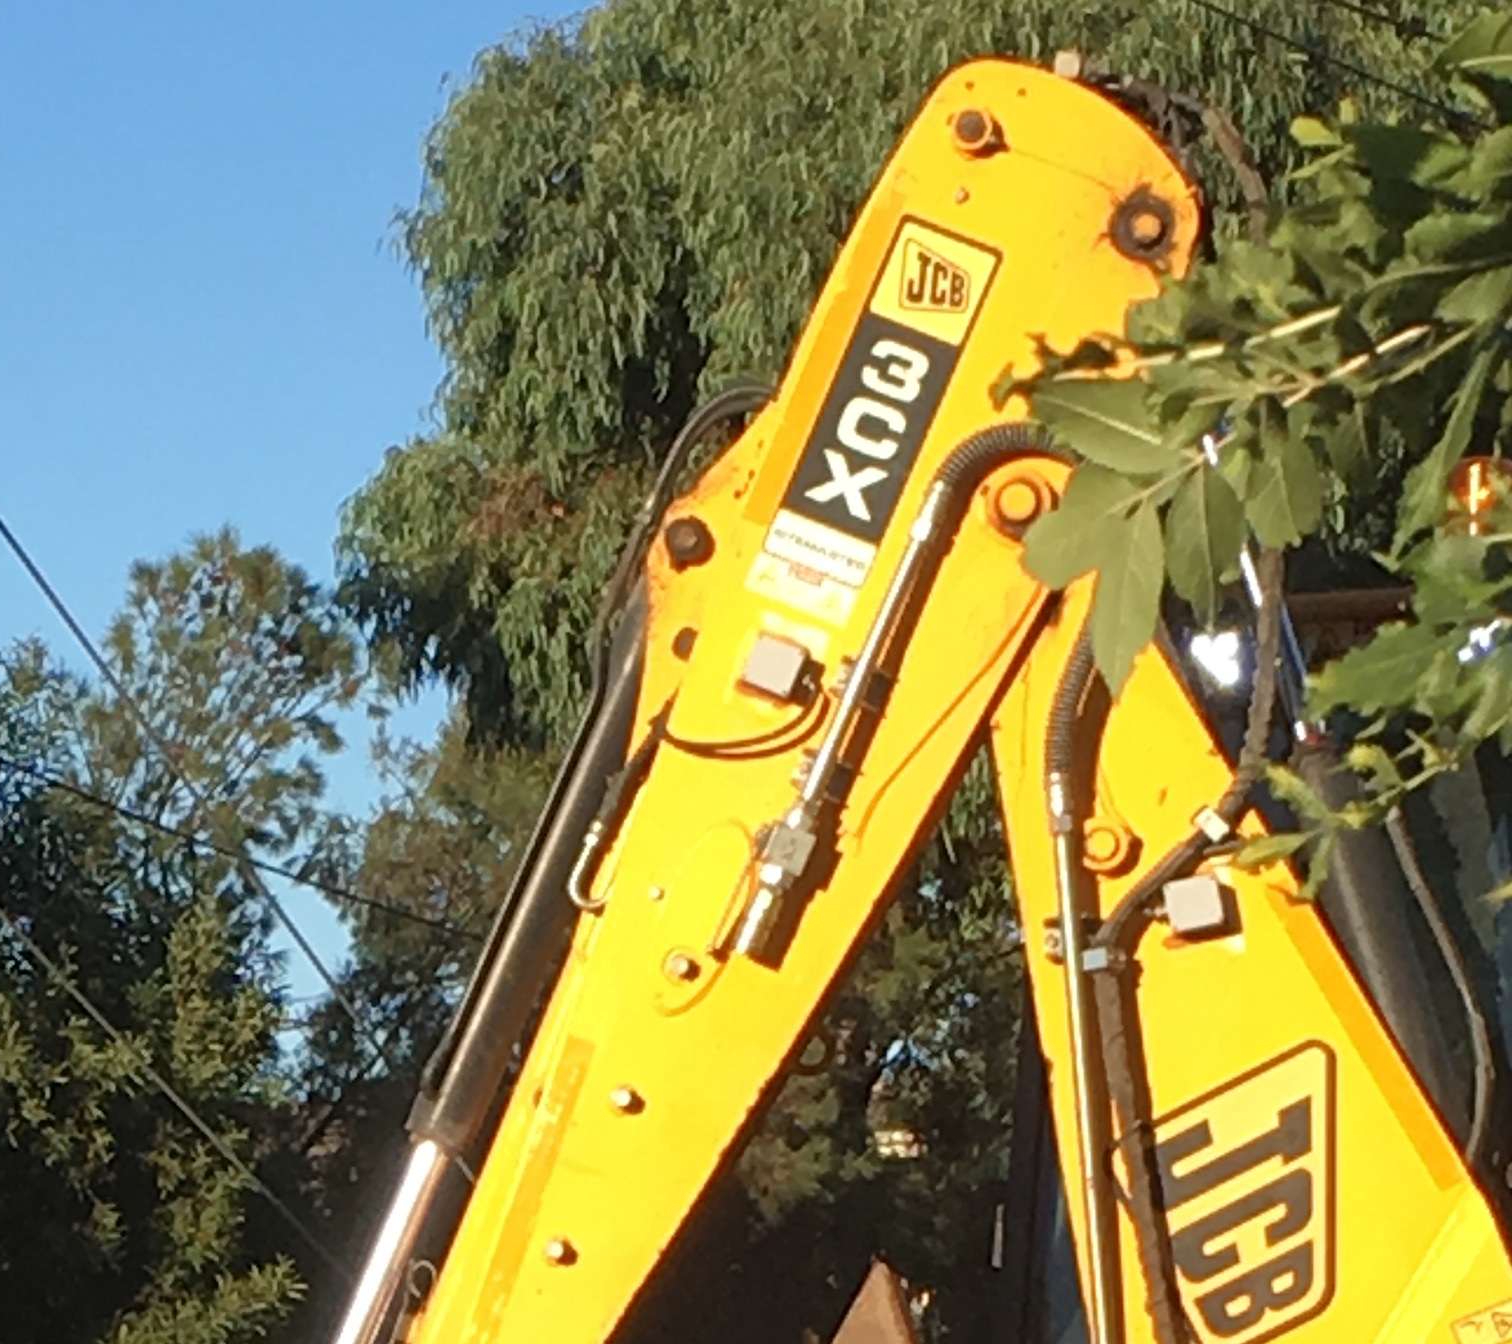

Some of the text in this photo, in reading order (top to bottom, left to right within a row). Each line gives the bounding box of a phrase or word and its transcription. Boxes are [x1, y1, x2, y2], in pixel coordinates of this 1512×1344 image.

[905, 250, 967, 308] JCB
[804, 338, 930, 522] 3CX
[1155, 1095, 1314, 1338] JCB
